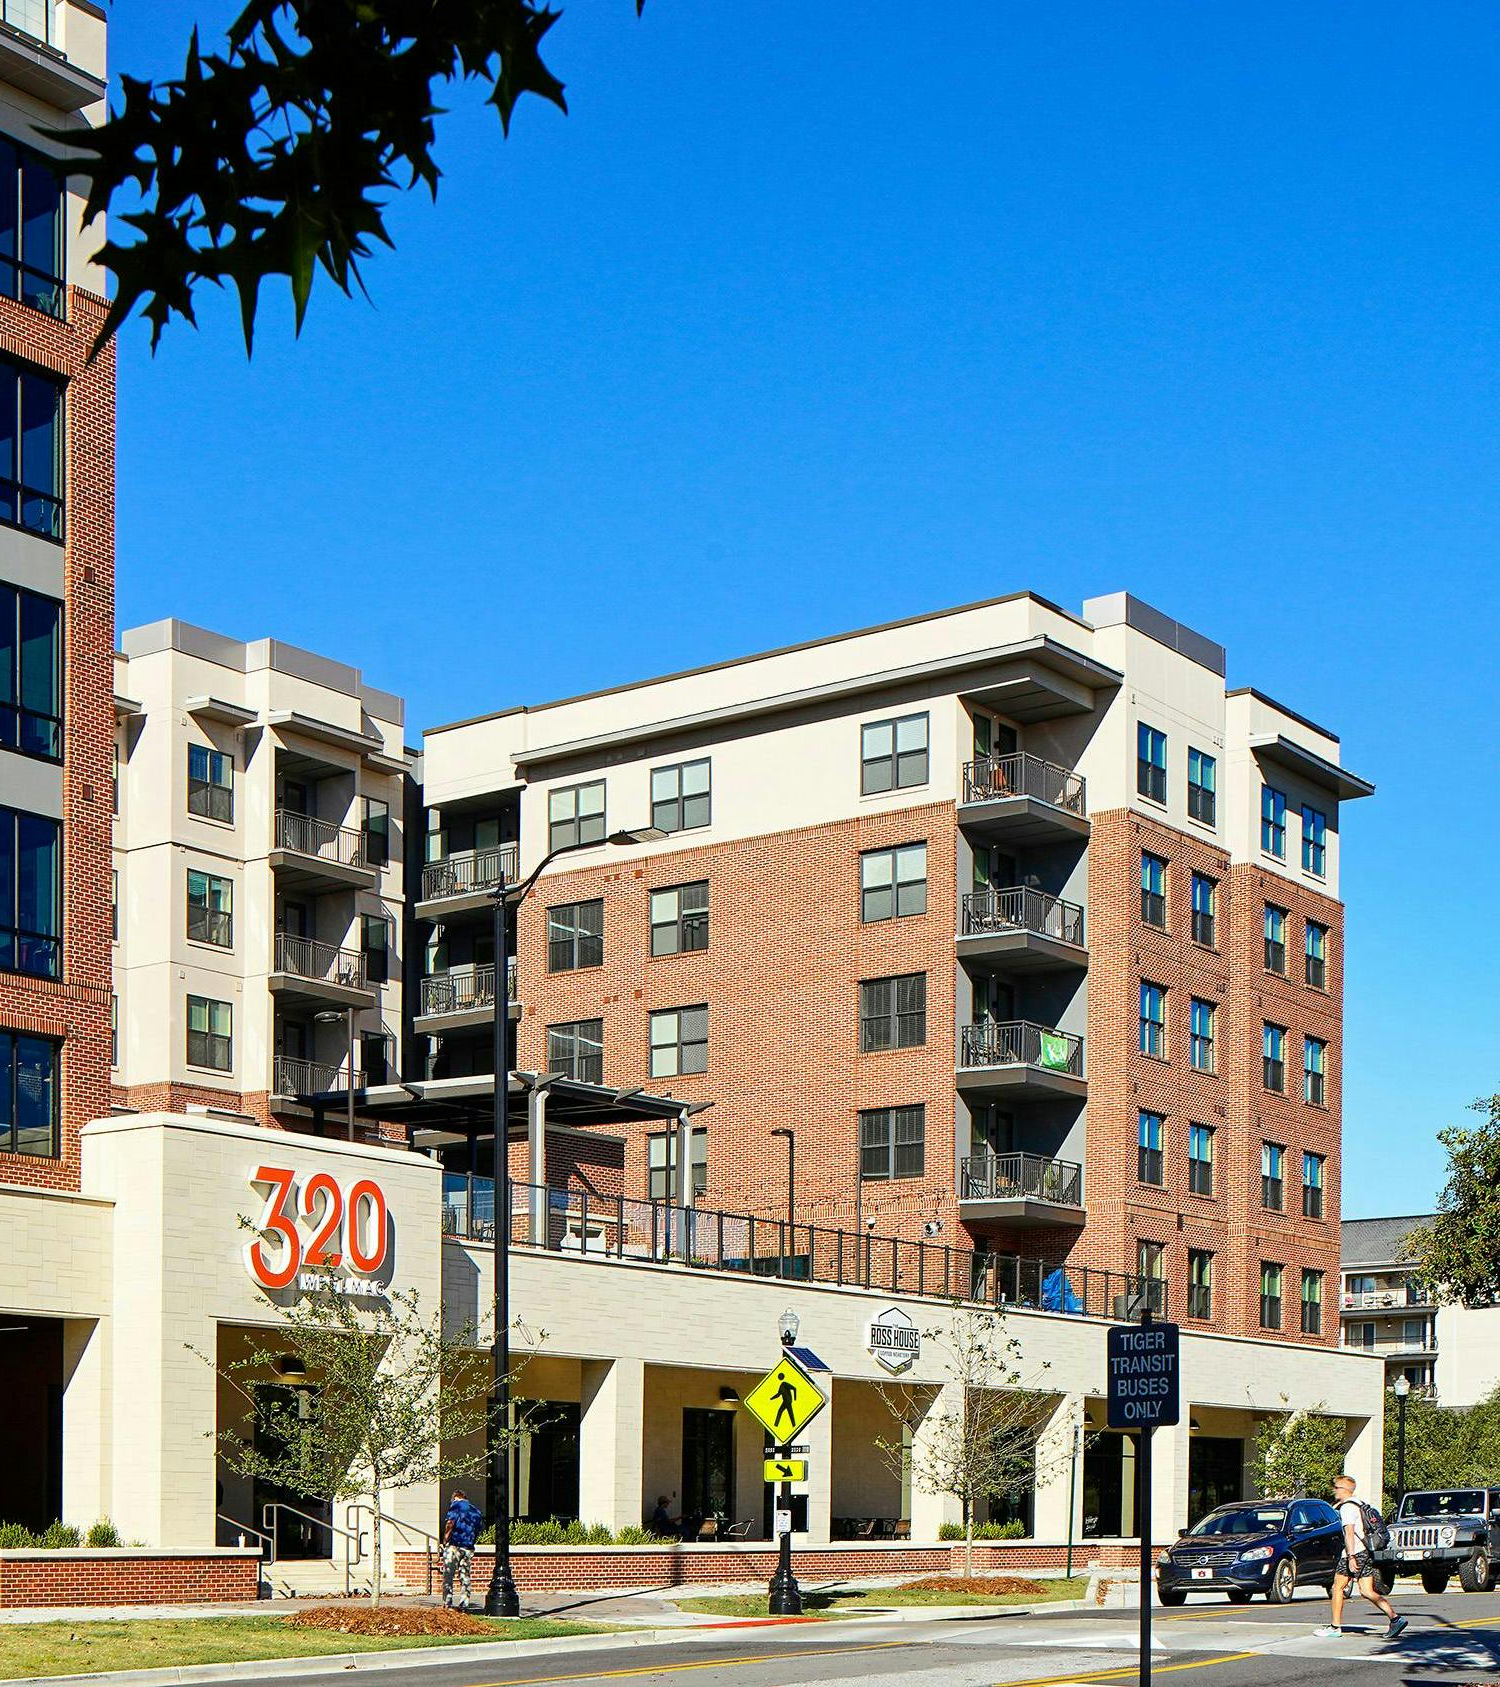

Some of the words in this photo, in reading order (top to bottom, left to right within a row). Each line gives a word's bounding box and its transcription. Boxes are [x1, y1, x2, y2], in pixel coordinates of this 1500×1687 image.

[244, 1165, 388, 1289] 320
[871, 1327, 892, 1346] ROSS
[894, 1330, 919, 1348] HOUSE
[1120, 1332, 1165, 1351] TIGER
[1111, 1354, 1175, 1375] TRANSIT
[1117, 1377, 1169, 1397] BUSES
[1124, 1401, 1162, 1419] ONLY
